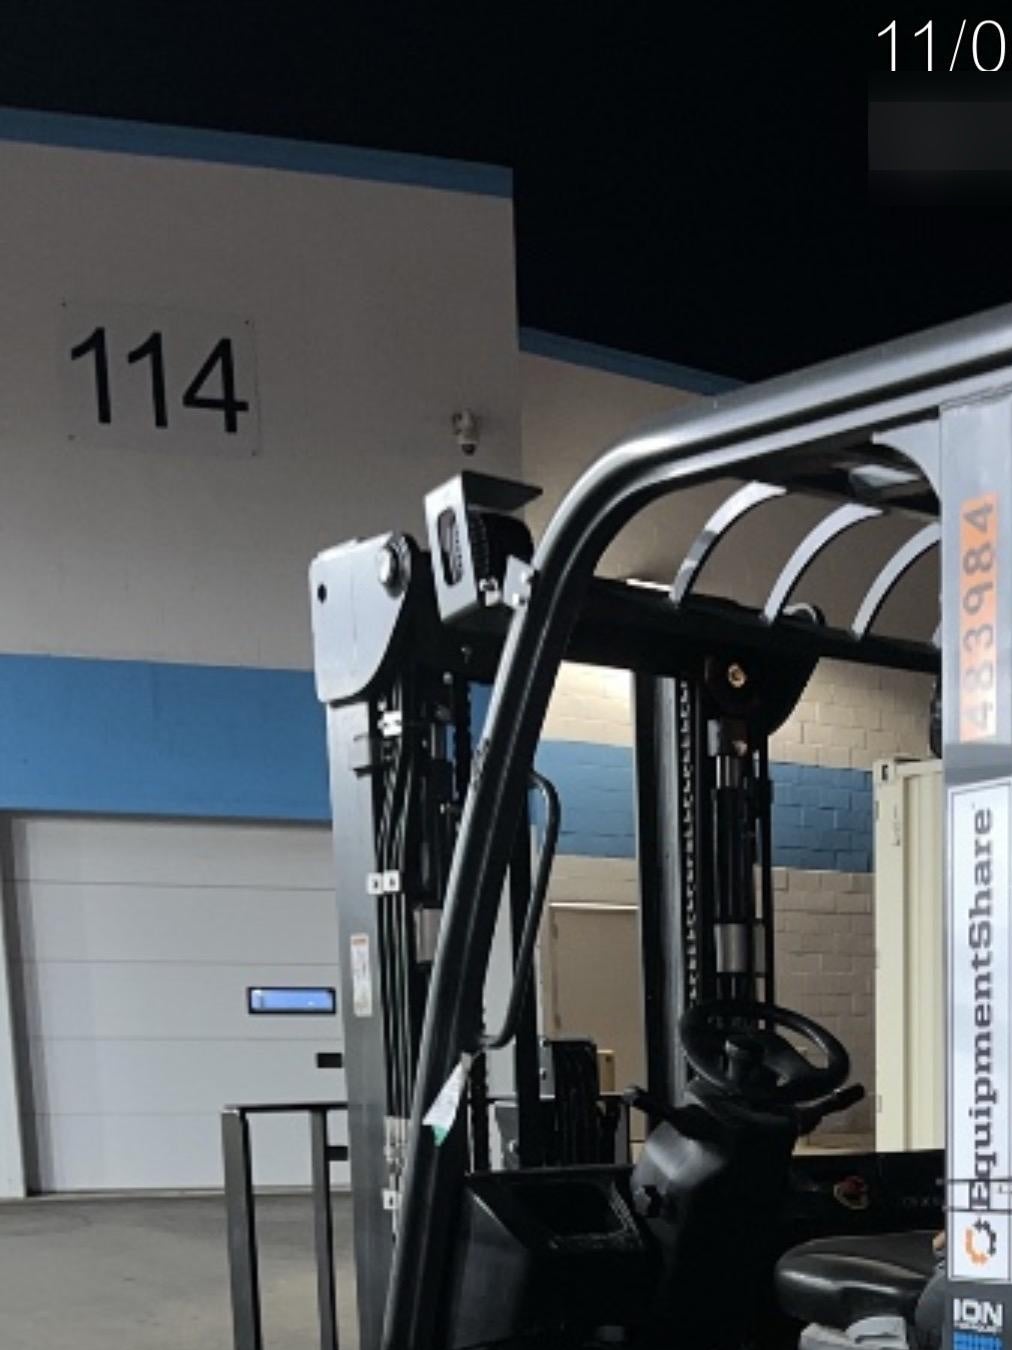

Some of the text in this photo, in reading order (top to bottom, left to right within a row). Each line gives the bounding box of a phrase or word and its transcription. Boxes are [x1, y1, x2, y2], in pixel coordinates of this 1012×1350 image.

[70, 327, 249, 434] 114
[962, 502, 994, 730] 483984
[968, 807, 998, 1211] EquipmentShare
[953, 1298, 1004, 1327] ION
